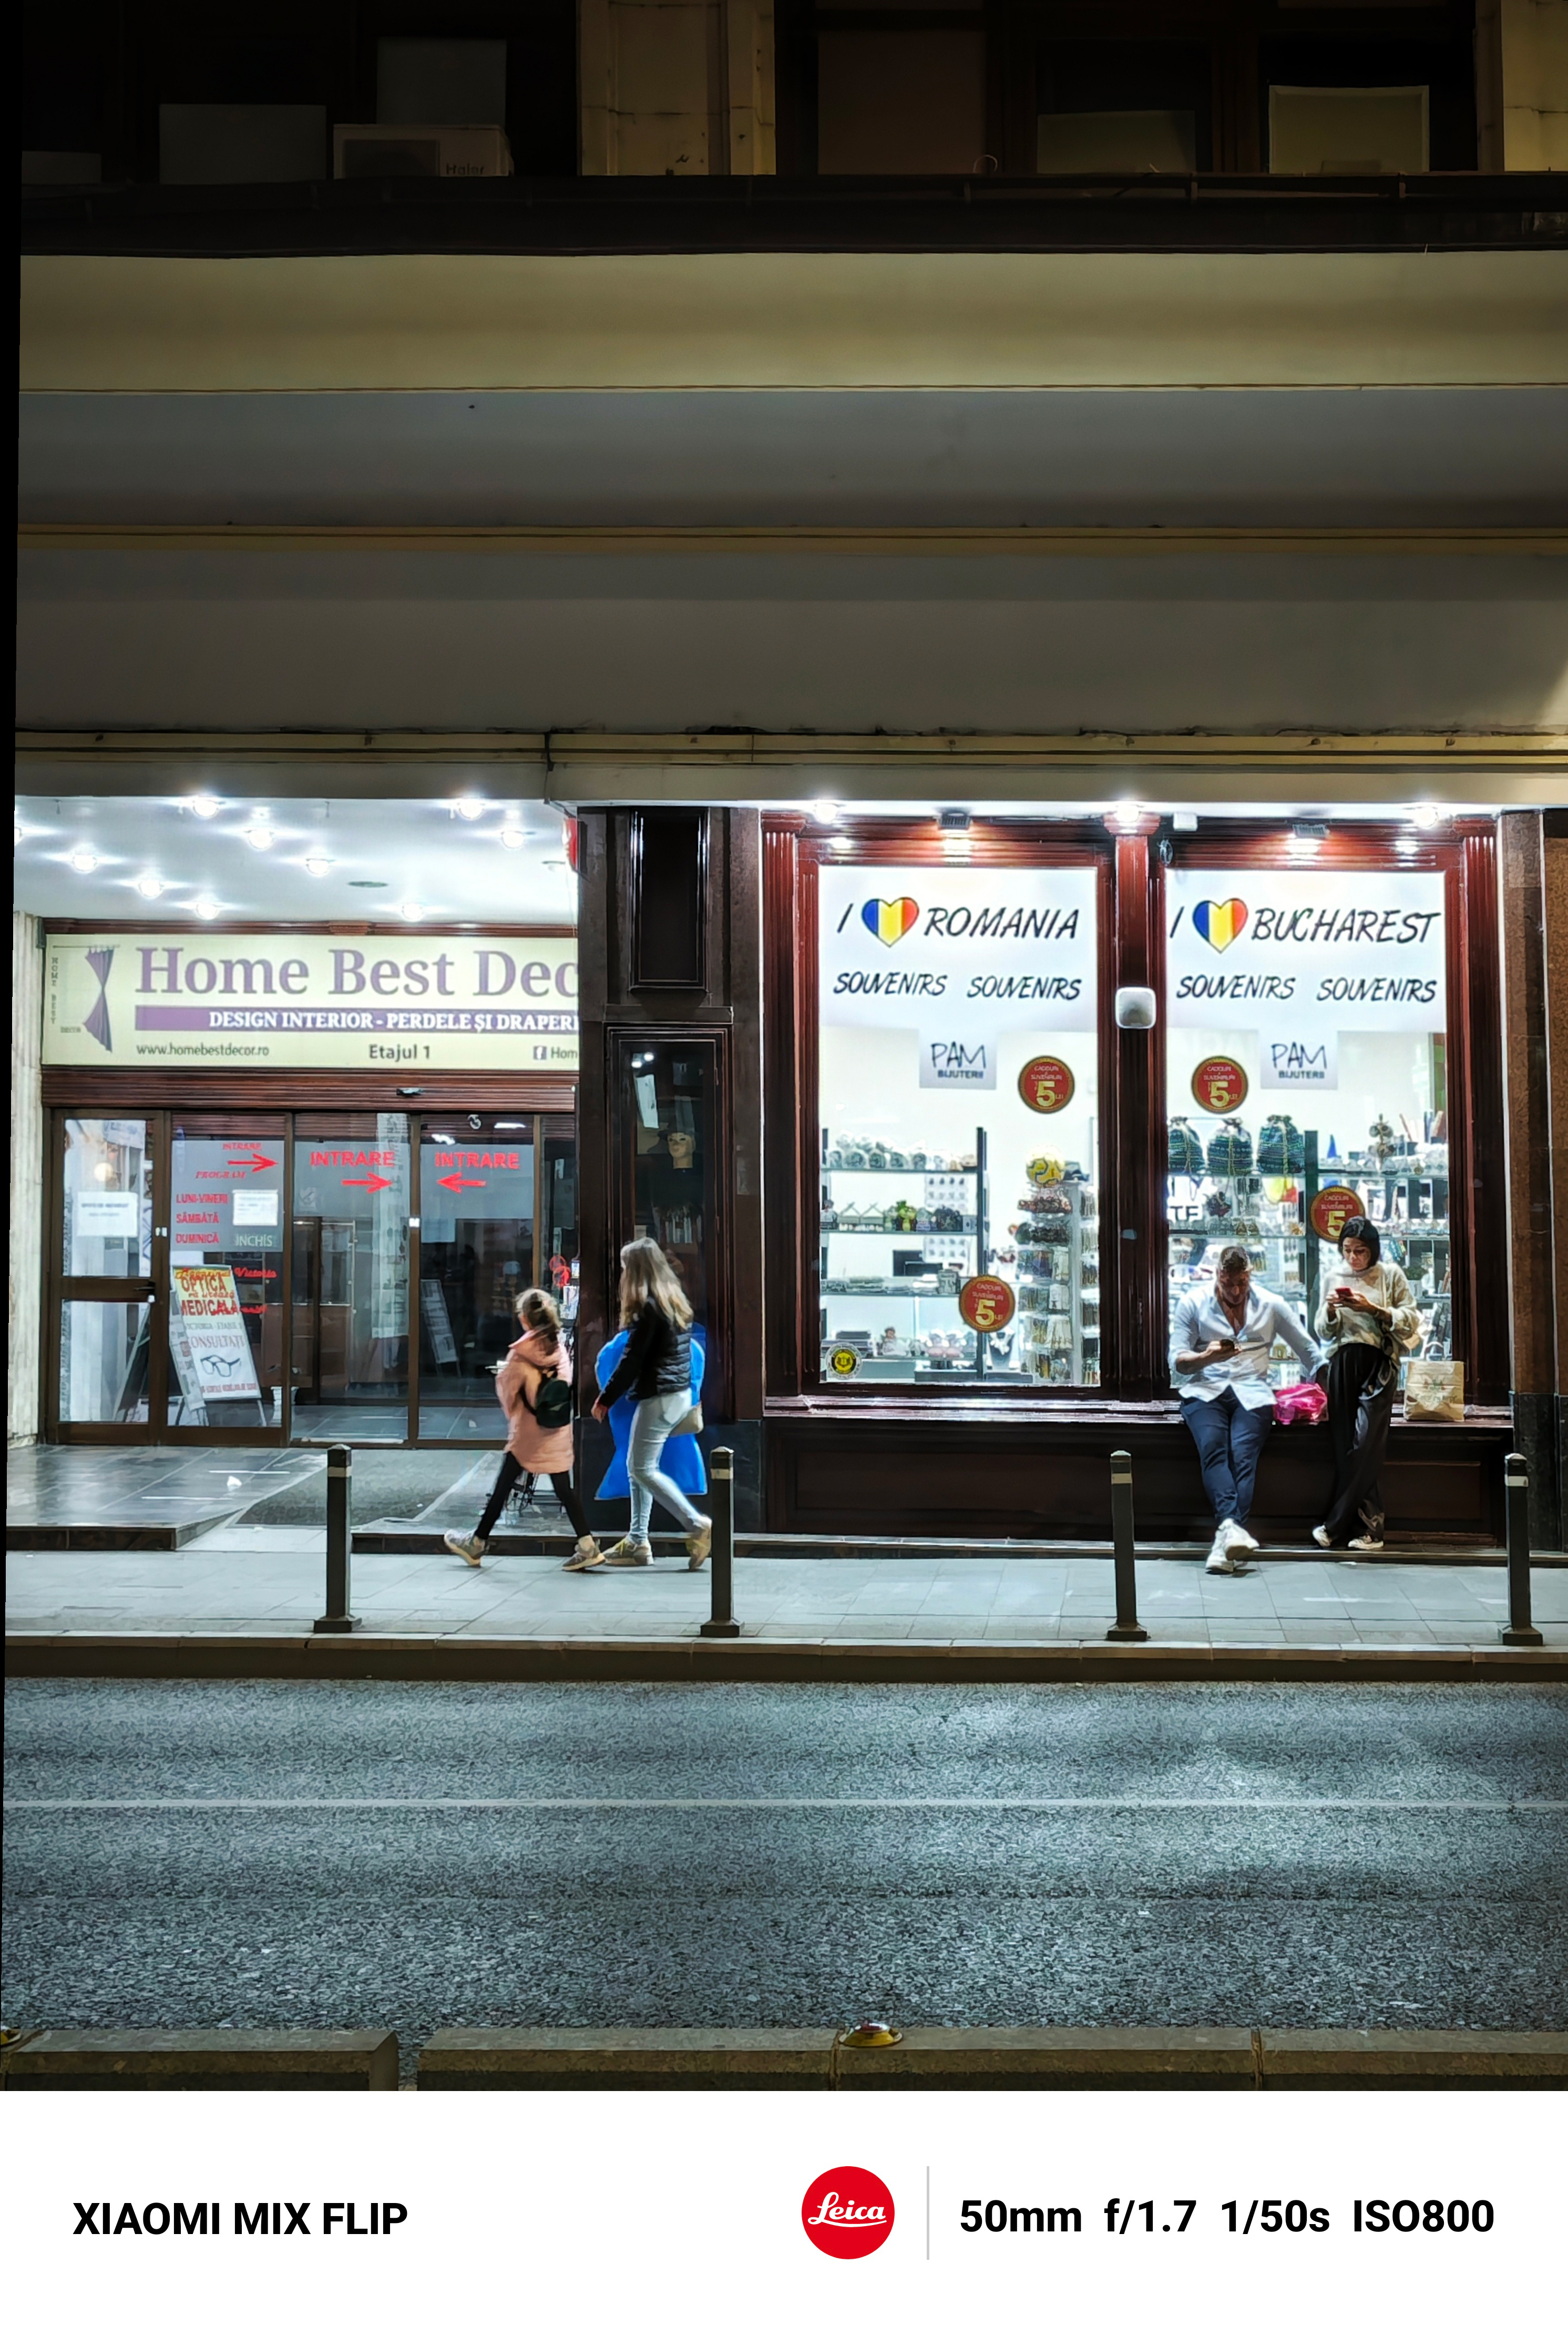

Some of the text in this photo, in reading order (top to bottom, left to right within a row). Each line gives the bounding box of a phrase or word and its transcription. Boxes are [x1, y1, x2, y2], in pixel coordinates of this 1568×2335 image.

[836, 903, 1079, 940] I ROMANIA
[1170, 906, 1442, 944] I BUCHAREST
[135, 947, 309, 995] Home
[327, 949, 455, 996] Best
[833, 971, 1082, 1001] SOUVENIRS SOUVENIRS
[1176, 974, 1437, 1003] SOUVENIRS SOUVENIRS
[209, 1011, 278, 1028] DESIGN
[282, 1011, 374, 1029] INTERIOR
[386, 1013, 472, 1029] PERDELE
[136, 1042, 270, 1056] www.homebestdecor.ro
[368, 1044, 431, 1063] Etajul 1
[930, 1041, 987, 1069] PAM
[1271, 1041, 1327, 1069] PAM
[1036, 1080, 1055, 1107] 5
[1210, 1080, 1229, 1107] 5
[222, 1142, 262, 1151] INTRARE
[310, 1151, 395, 1167] INTRARE
[435, 1151, 521, 1170] INTRARE
[176, 1194, 229, 1205] LUNI-VINERI
[1327, 1210, 1345, 1237] 5
[975, 1299, 996, 1325] 5
